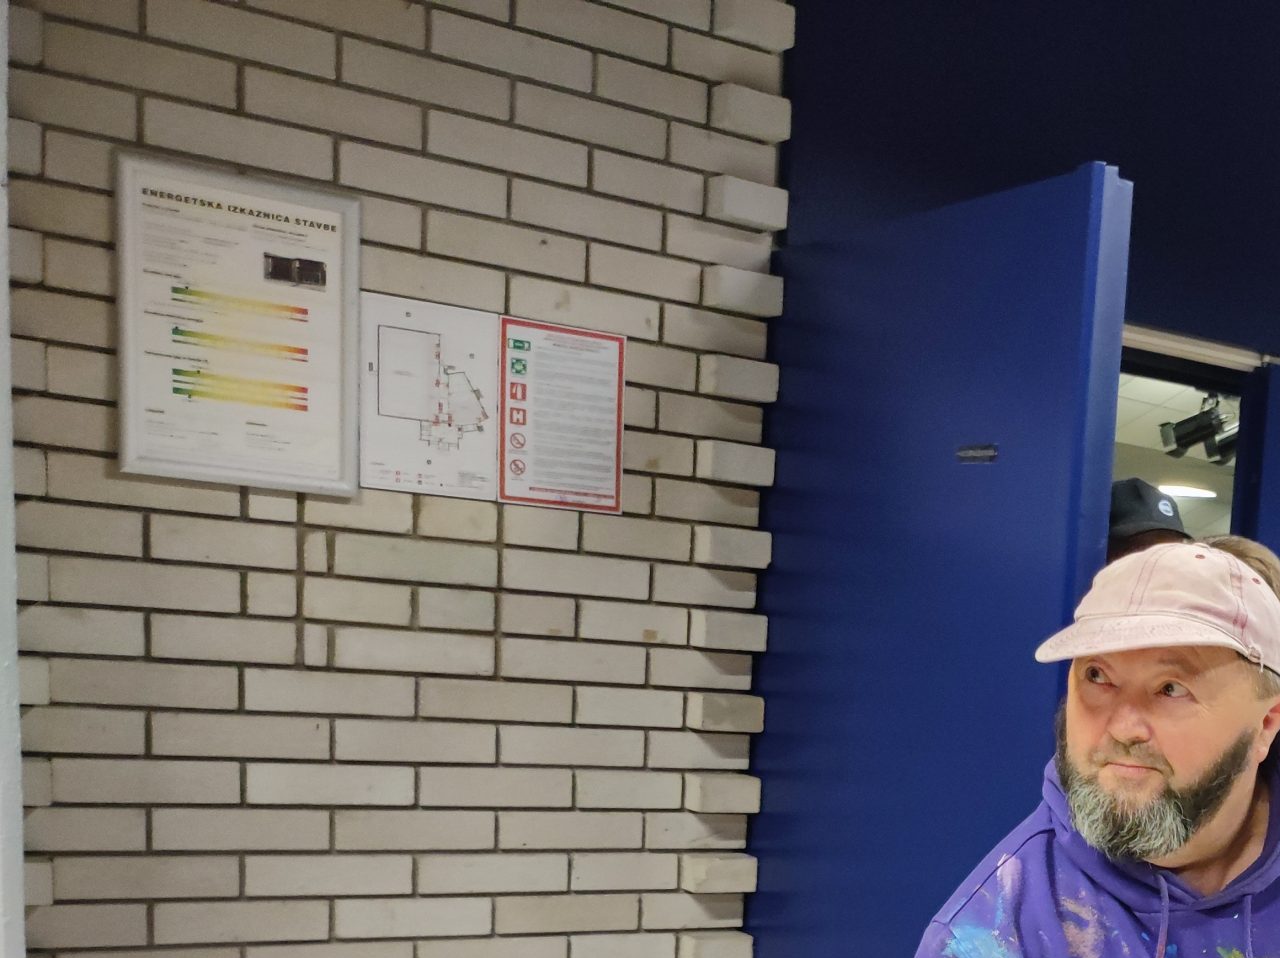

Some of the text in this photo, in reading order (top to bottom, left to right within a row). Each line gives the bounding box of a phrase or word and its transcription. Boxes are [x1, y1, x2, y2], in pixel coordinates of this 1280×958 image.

[141, 187, 224, 211] ENERGETSKA
[227, 203, 291, 224] IZKAZNICA
[294, 217, 338, 233] STAVBE
